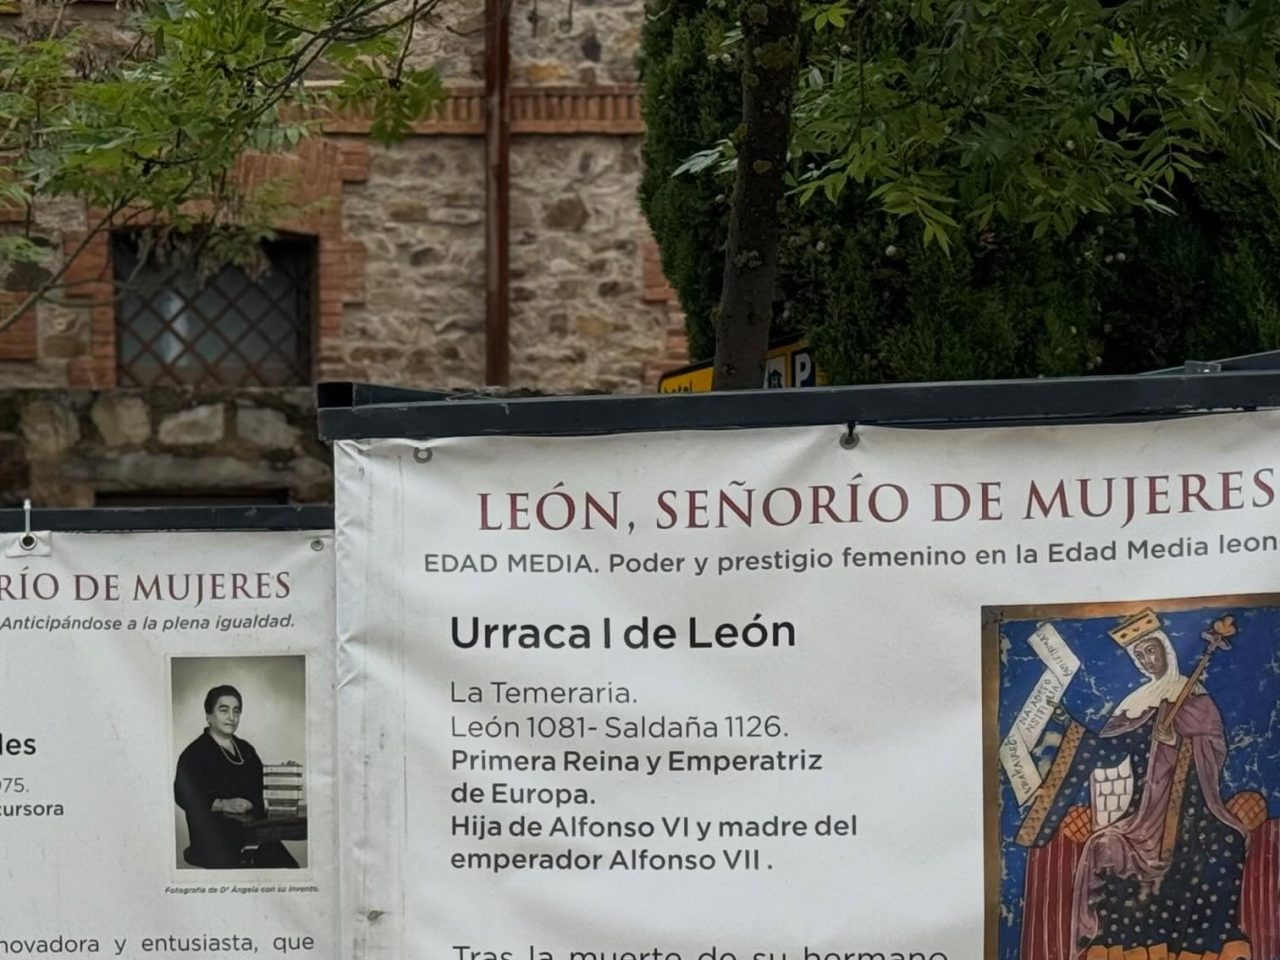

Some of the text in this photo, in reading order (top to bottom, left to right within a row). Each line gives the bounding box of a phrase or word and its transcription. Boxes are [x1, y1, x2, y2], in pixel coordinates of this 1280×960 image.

[476, 468, 1274, 535] LEÓN, SEÑORÍO DE MUJERES
[424, 536, 1208, 575] EDAD MEDIA. Poder y prestigio femenino en la Edad Media
[73, 574, 119, 601] DE
[132, 571, 290, 607] MUJERES
[0, 615, 122, 632] Anticipándose
[127, 619, 137, 630] a
[142, 615, 157, 630] la
[162, 615, 210, 632] plena
[215, 613, 295, 632] igualdad.
[451, 612, 795, 650] Urraca I de León
[450, 680, 637, 704] La Temeraria.
[451, 714, 788, 739] León 1081- Saldaña 1126.
[452, 748, 822, 776] Primera Reina y Emperatriz
[450, 782, 595, 808] de Europa.
